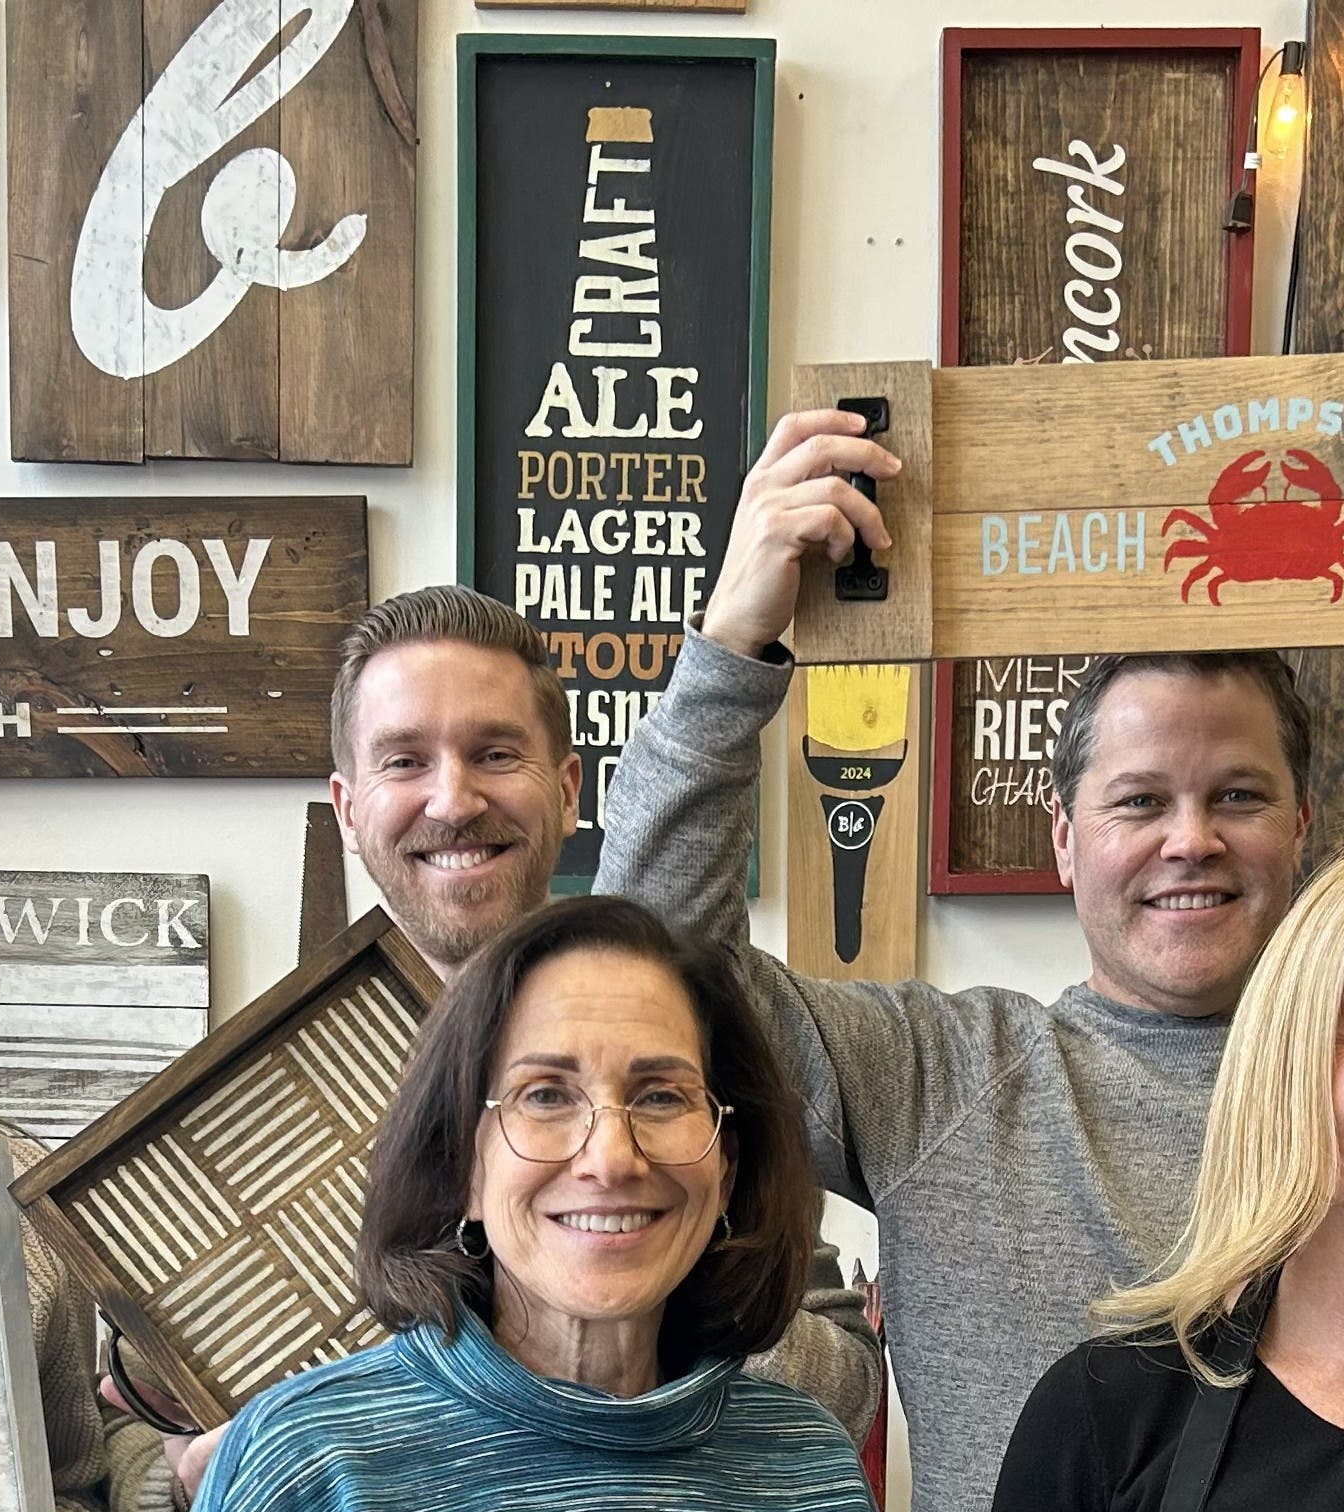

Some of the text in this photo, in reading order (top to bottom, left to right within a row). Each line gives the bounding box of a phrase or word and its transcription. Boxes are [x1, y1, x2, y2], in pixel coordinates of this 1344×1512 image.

[567, 143, 663, 358] CRAFT
[1032, 138, 1127, 365] ncork
[524, 361, 704, 440] ALE
[517, 450, 708, 503] PORTER
[516, 507, 707, 556] LAGER
[981, 511, 1146, 577] BEACH
[514, 563, 706, 624] PALE ALE
[840, 767, 871, 779] 2024
